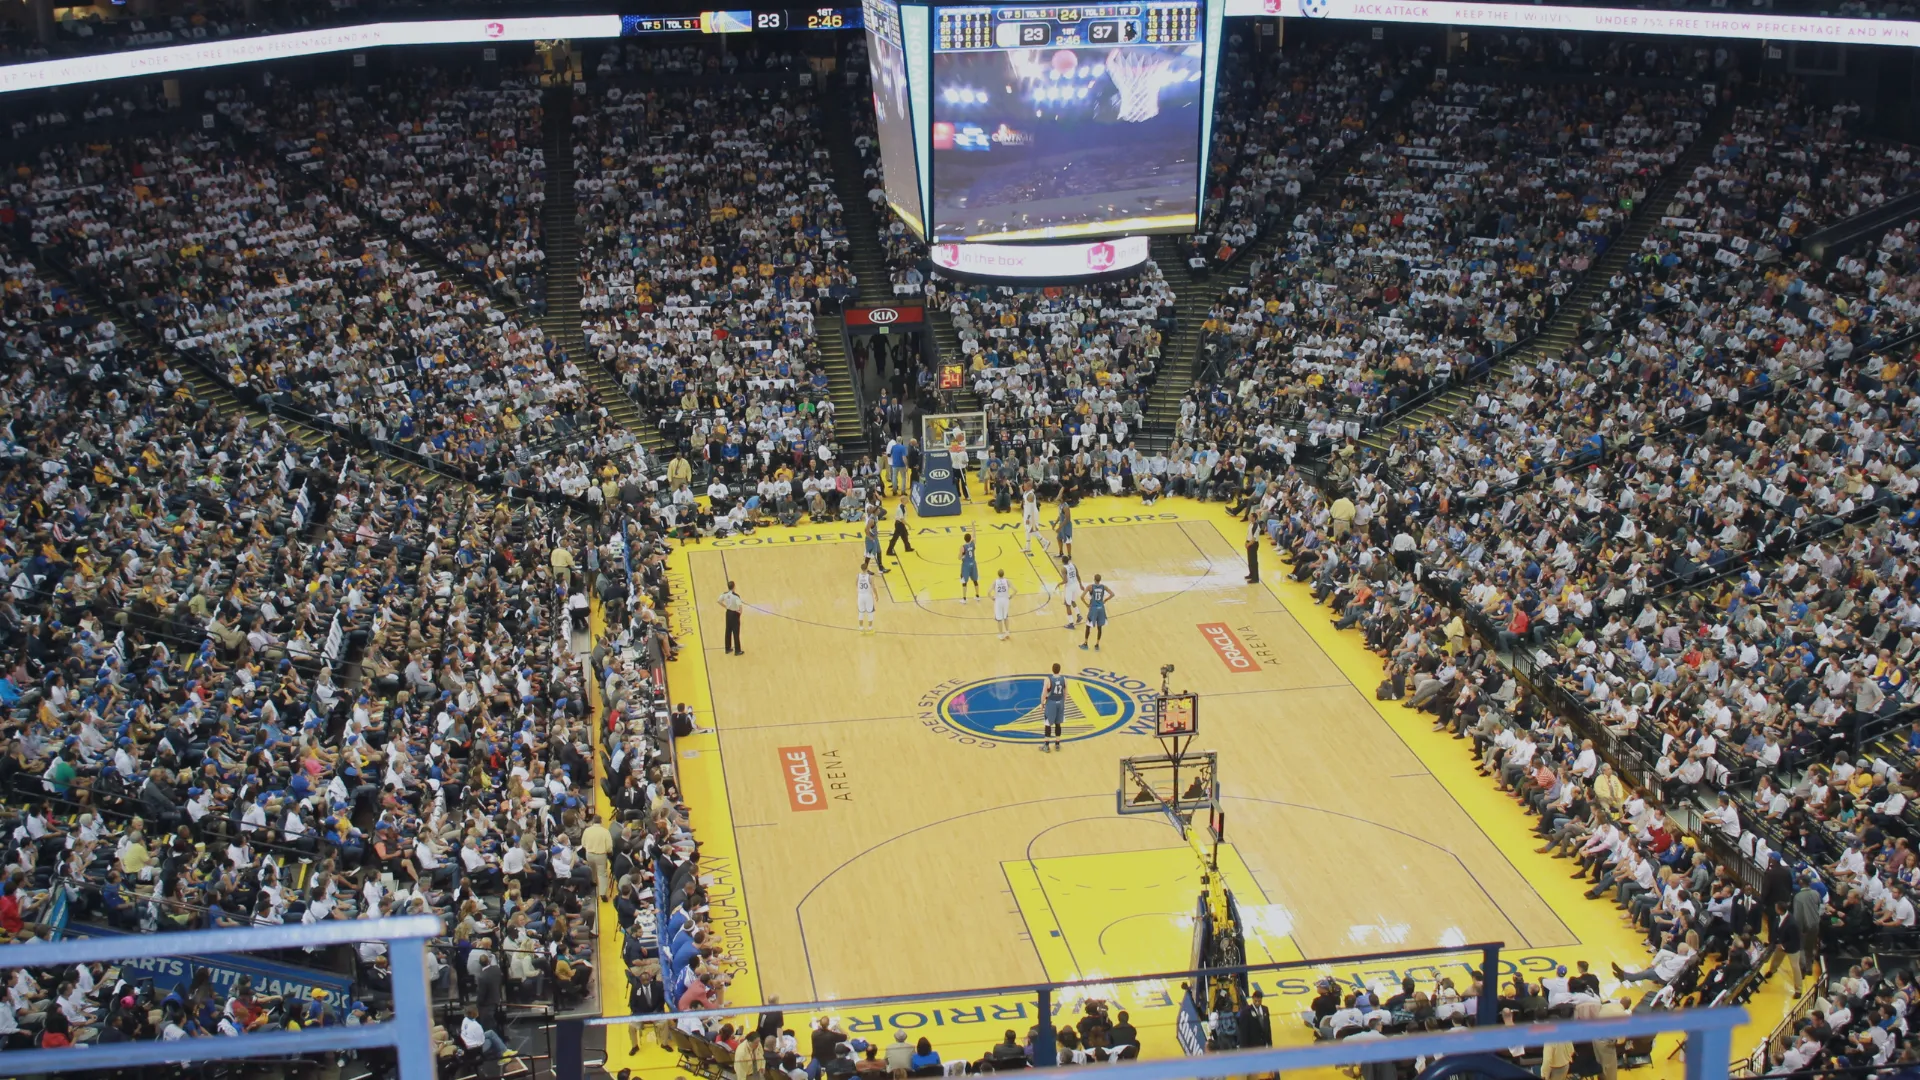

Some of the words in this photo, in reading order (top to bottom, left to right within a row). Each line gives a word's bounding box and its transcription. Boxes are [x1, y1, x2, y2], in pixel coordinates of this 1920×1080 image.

[1060, 9, 1078, 20] 24
[1353, 4, 1382, 14] JACK
[1385, 5, 1429, 16] ATTACK
[1455, 9, 1484, 19] KEEP
[1488, 10, 1508, 20] THE
[642, 21, 652, 29] TF
[653, 20, 661, 29] 5
[666, 21, 682, 29] TOL
[684, 20, 691, 29] 5
[693, 20, 699, 29] 1
[758, 13, 780, 28] 23
[807, 15, 842, 28] 2:46
[1596, 15, 1638, 25] UNDER
[1669, 18, 1699, 29] FREE
[1705, 20, 1750, 31] THROW
[1757, 22, 1841, 35] PERCENTAGE
[1848, 27, 1877, 37] AND
[1883, 28, 1909, 38] WIN
[1023, 28, 1044, 41] 23
[1093, 25, 1113, 39] 37
[1056, 35, 1080, 45] 2:46
[131, 55, 168, 68] UNDER
[197, 48, 222, 60] FREE
[337, 34, 357, 43] AND
[908, 14, 926, 104] JAWBONE
[962, 253, 972, 264] in
[975, 252, 995, 265] the
[998, 254, 1024, 266] box
[874, 312, 893, 321] KIA
[942, 373, 961, 388] 24
[930, 494, 951, 504] KIA
[712, 531, 862, 546] GOLDEN
[877, 524, 983, 538] SATE
[990, 513, 1179, 531] WRIORS
[968, 550, 974, 558] 9
[1095, 592, 1102, 600] 13
[1205, 626, 1250, 668] ORACLE
[1237, 625, 1282, 665] ARENA
[918, 677, 966, 708] STATE
[1053, 685, 1062, 694] 42
[1078, 666, 1160, 737] WARRIORS
[920, 712, 997, 750] GOLDEN
[787, 751, 818, 805] ORACLE
[821, 749, 854, 802] ARENA
[699, 855, 740, 921] GALAXY
[723, 920, 748, 977] Samsung
